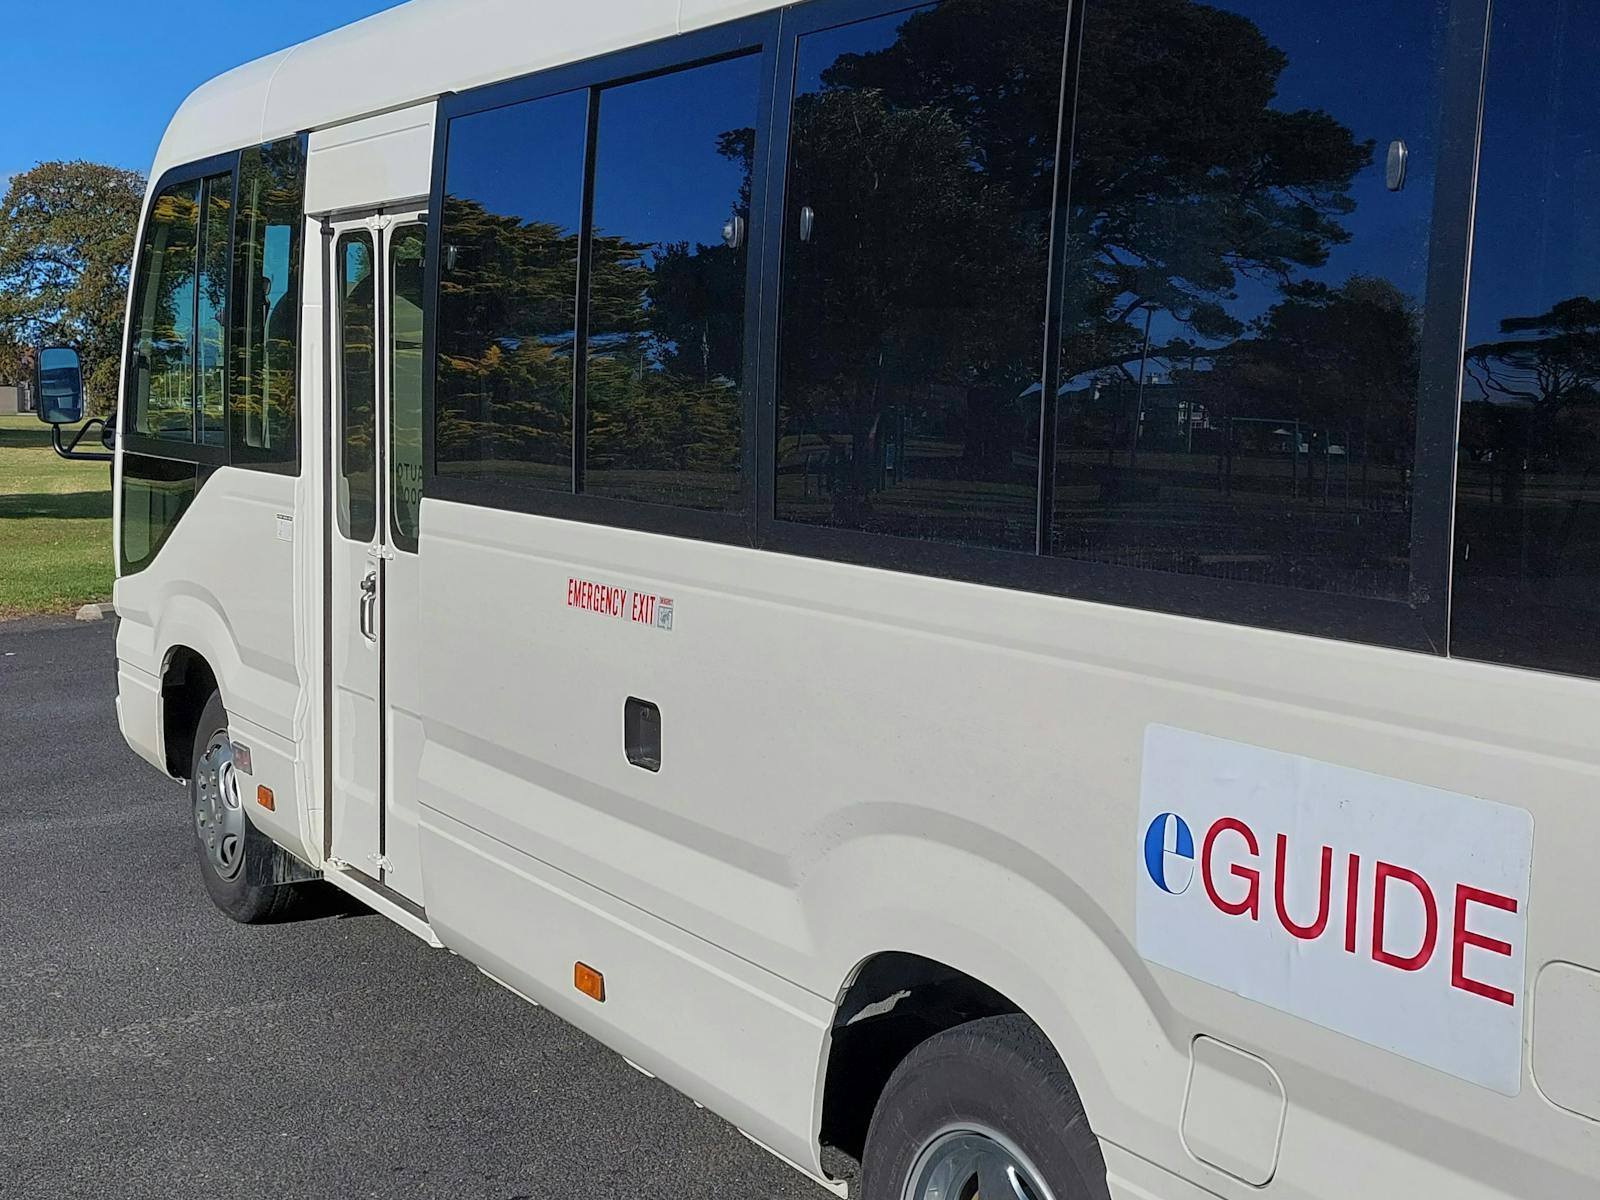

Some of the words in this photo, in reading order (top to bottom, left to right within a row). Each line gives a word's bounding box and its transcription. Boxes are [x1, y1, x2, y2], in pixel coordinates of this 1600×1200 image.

[567, 578, 627, 618] EMERGENCY
[632, 592, 656, 625] EXIT
[1144, 812, 1518, 1006] eGUIDE
